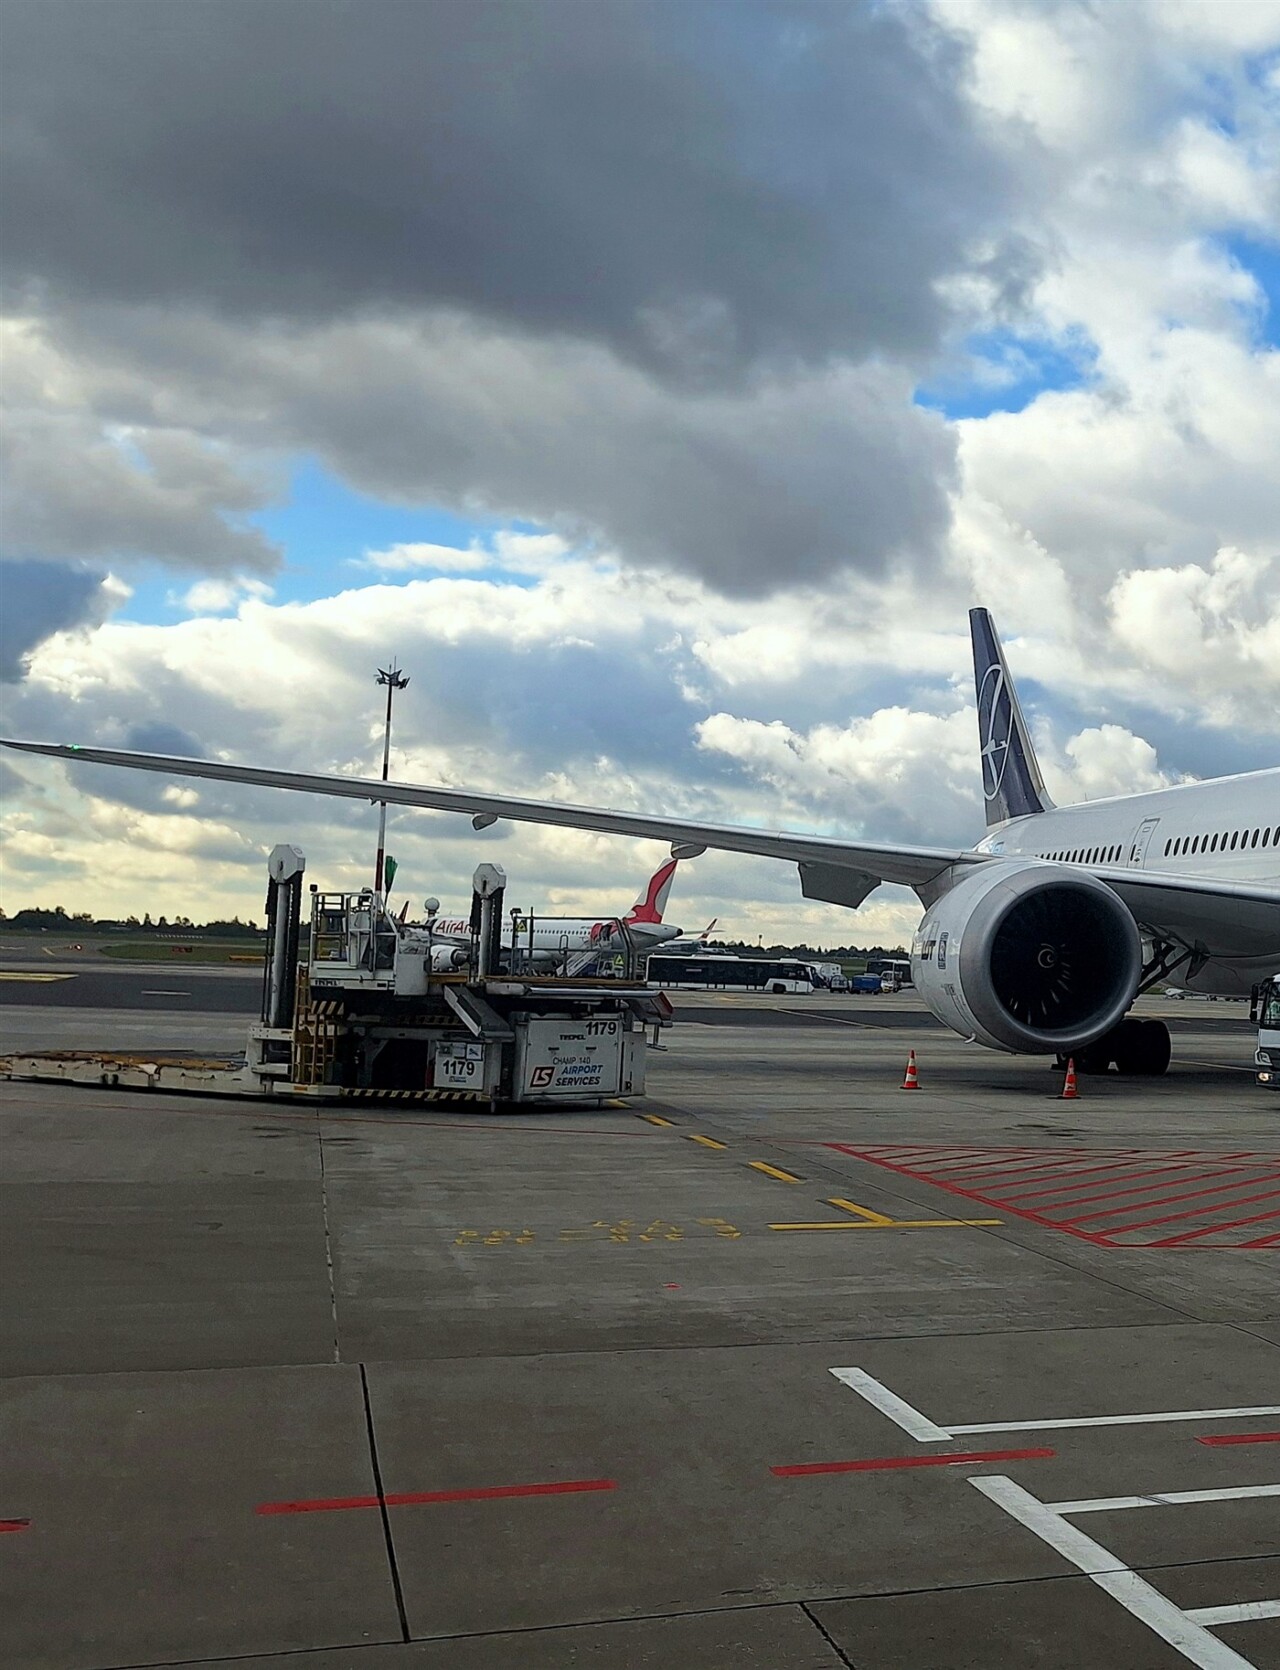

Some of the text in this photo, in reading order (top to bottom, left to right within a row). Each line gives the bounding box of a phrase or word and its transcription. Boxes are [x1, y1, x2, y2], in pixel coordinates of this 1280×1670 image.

[585, 1021, 617, 1036] 1179
[443, 1059, 475, 1076] 1179
[552, 1056, 577, 1066] CHAMP
[561, 1064, 603, 1076] AIRPORT
[530, 1067, 556, 1088] LS
[555, 1076, 601, 1087] SERVICES
